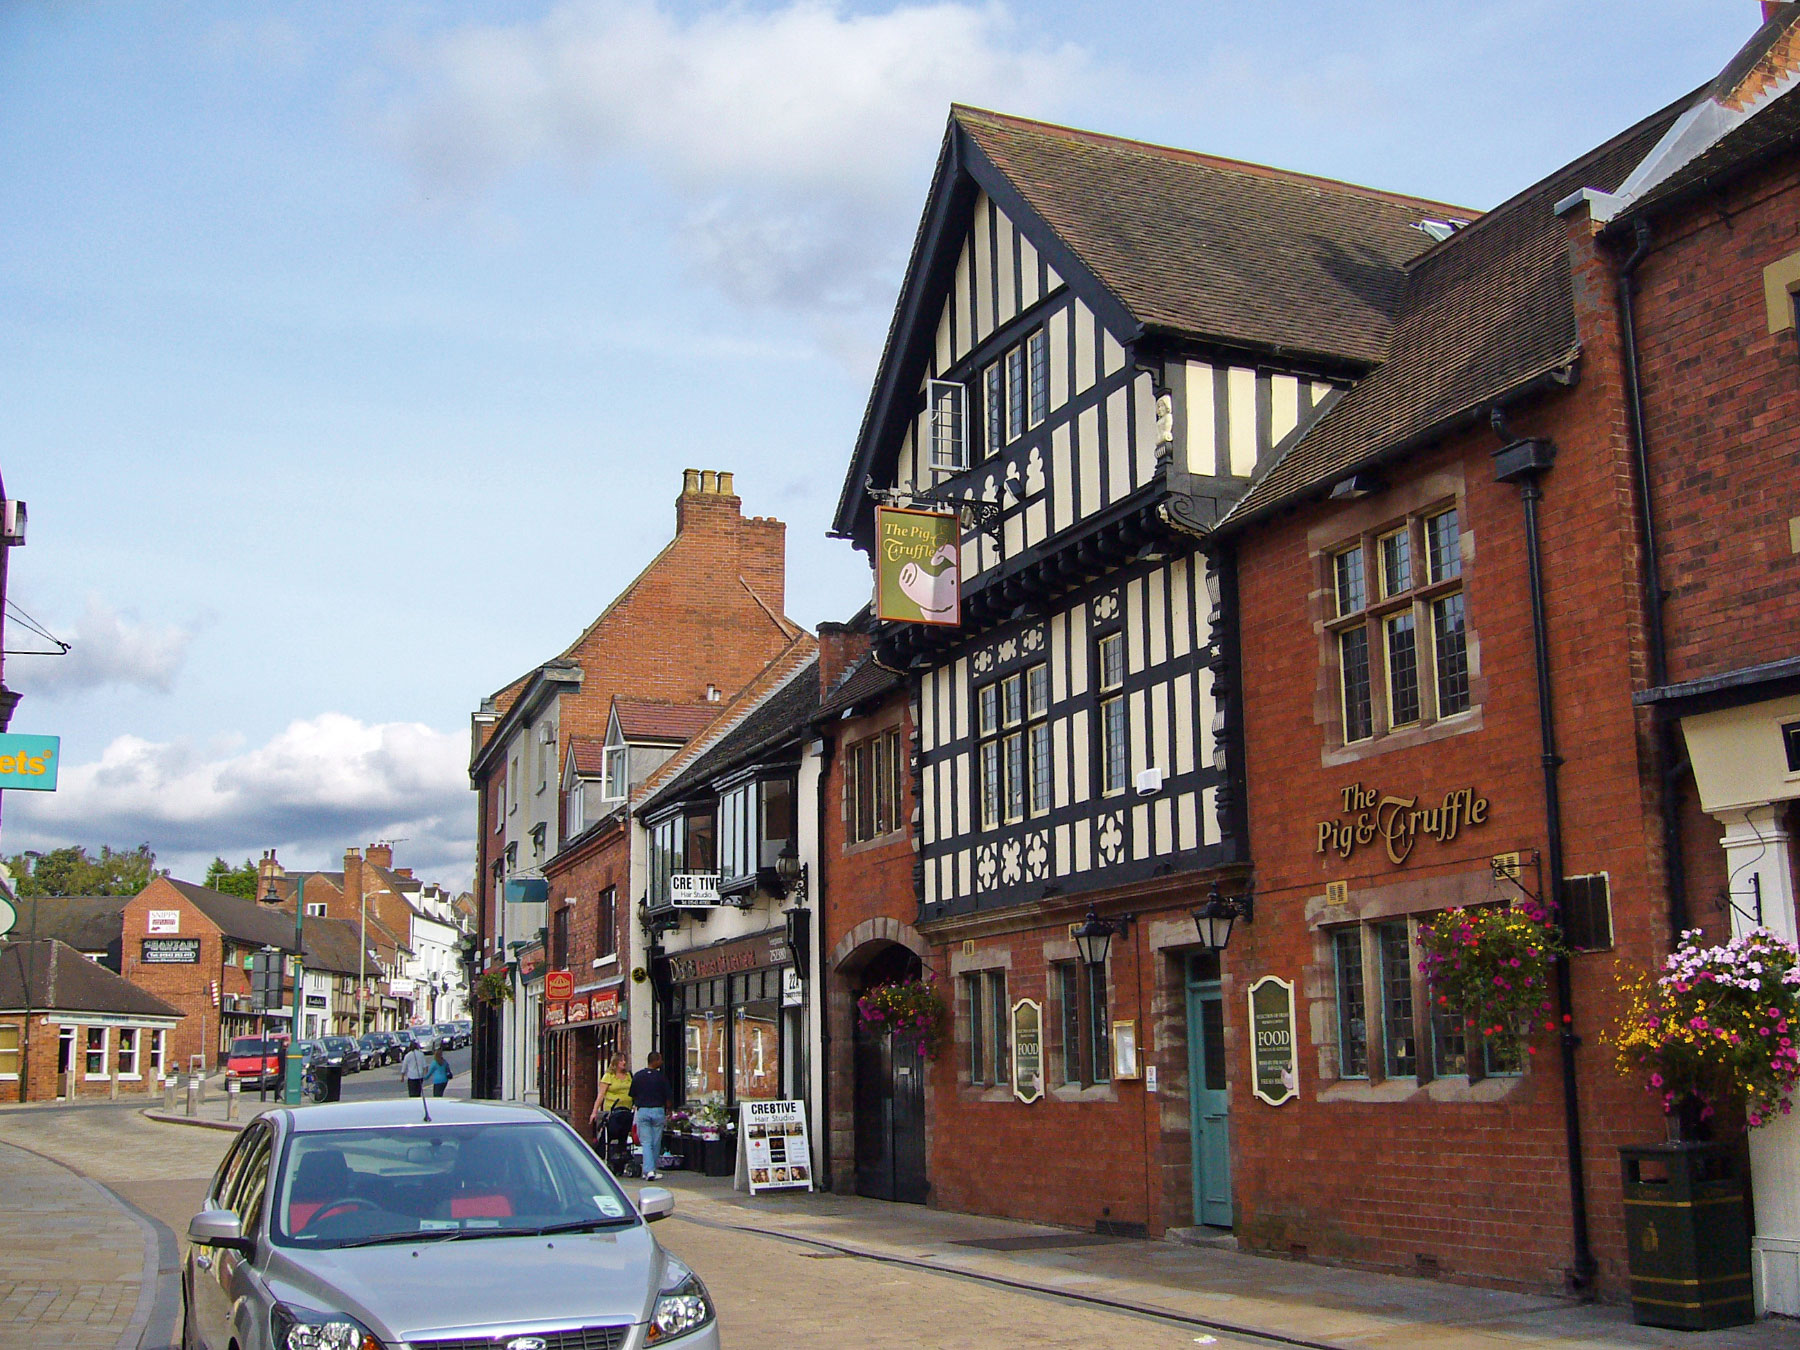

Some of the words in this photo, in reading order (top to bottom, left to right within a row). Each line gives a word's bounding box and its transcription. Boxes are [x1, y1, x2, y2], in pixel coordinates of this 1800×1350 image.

[885, 523, 909, 537] The
[910, 526, 931, 543] Pig
[883, 538, 937, 562] Truffle
[1341, 783, 1377, 813] The
[1316, 821, 1353, 858] Pig
[1356, 813, 1376, 844] &
[1376, 788, 1488, 865] Truffle
[693, 891, 713, 899] Studio
[151, 911, 178, 919] SNIPPS
[1258, 1030, 1290, 1046] FOOD
[1017, 1042, 1039, 1056] FOOD
[751, 1102, 797, 1114] CRE8TIVE
[772, 1114, 795, 1122] Studio
